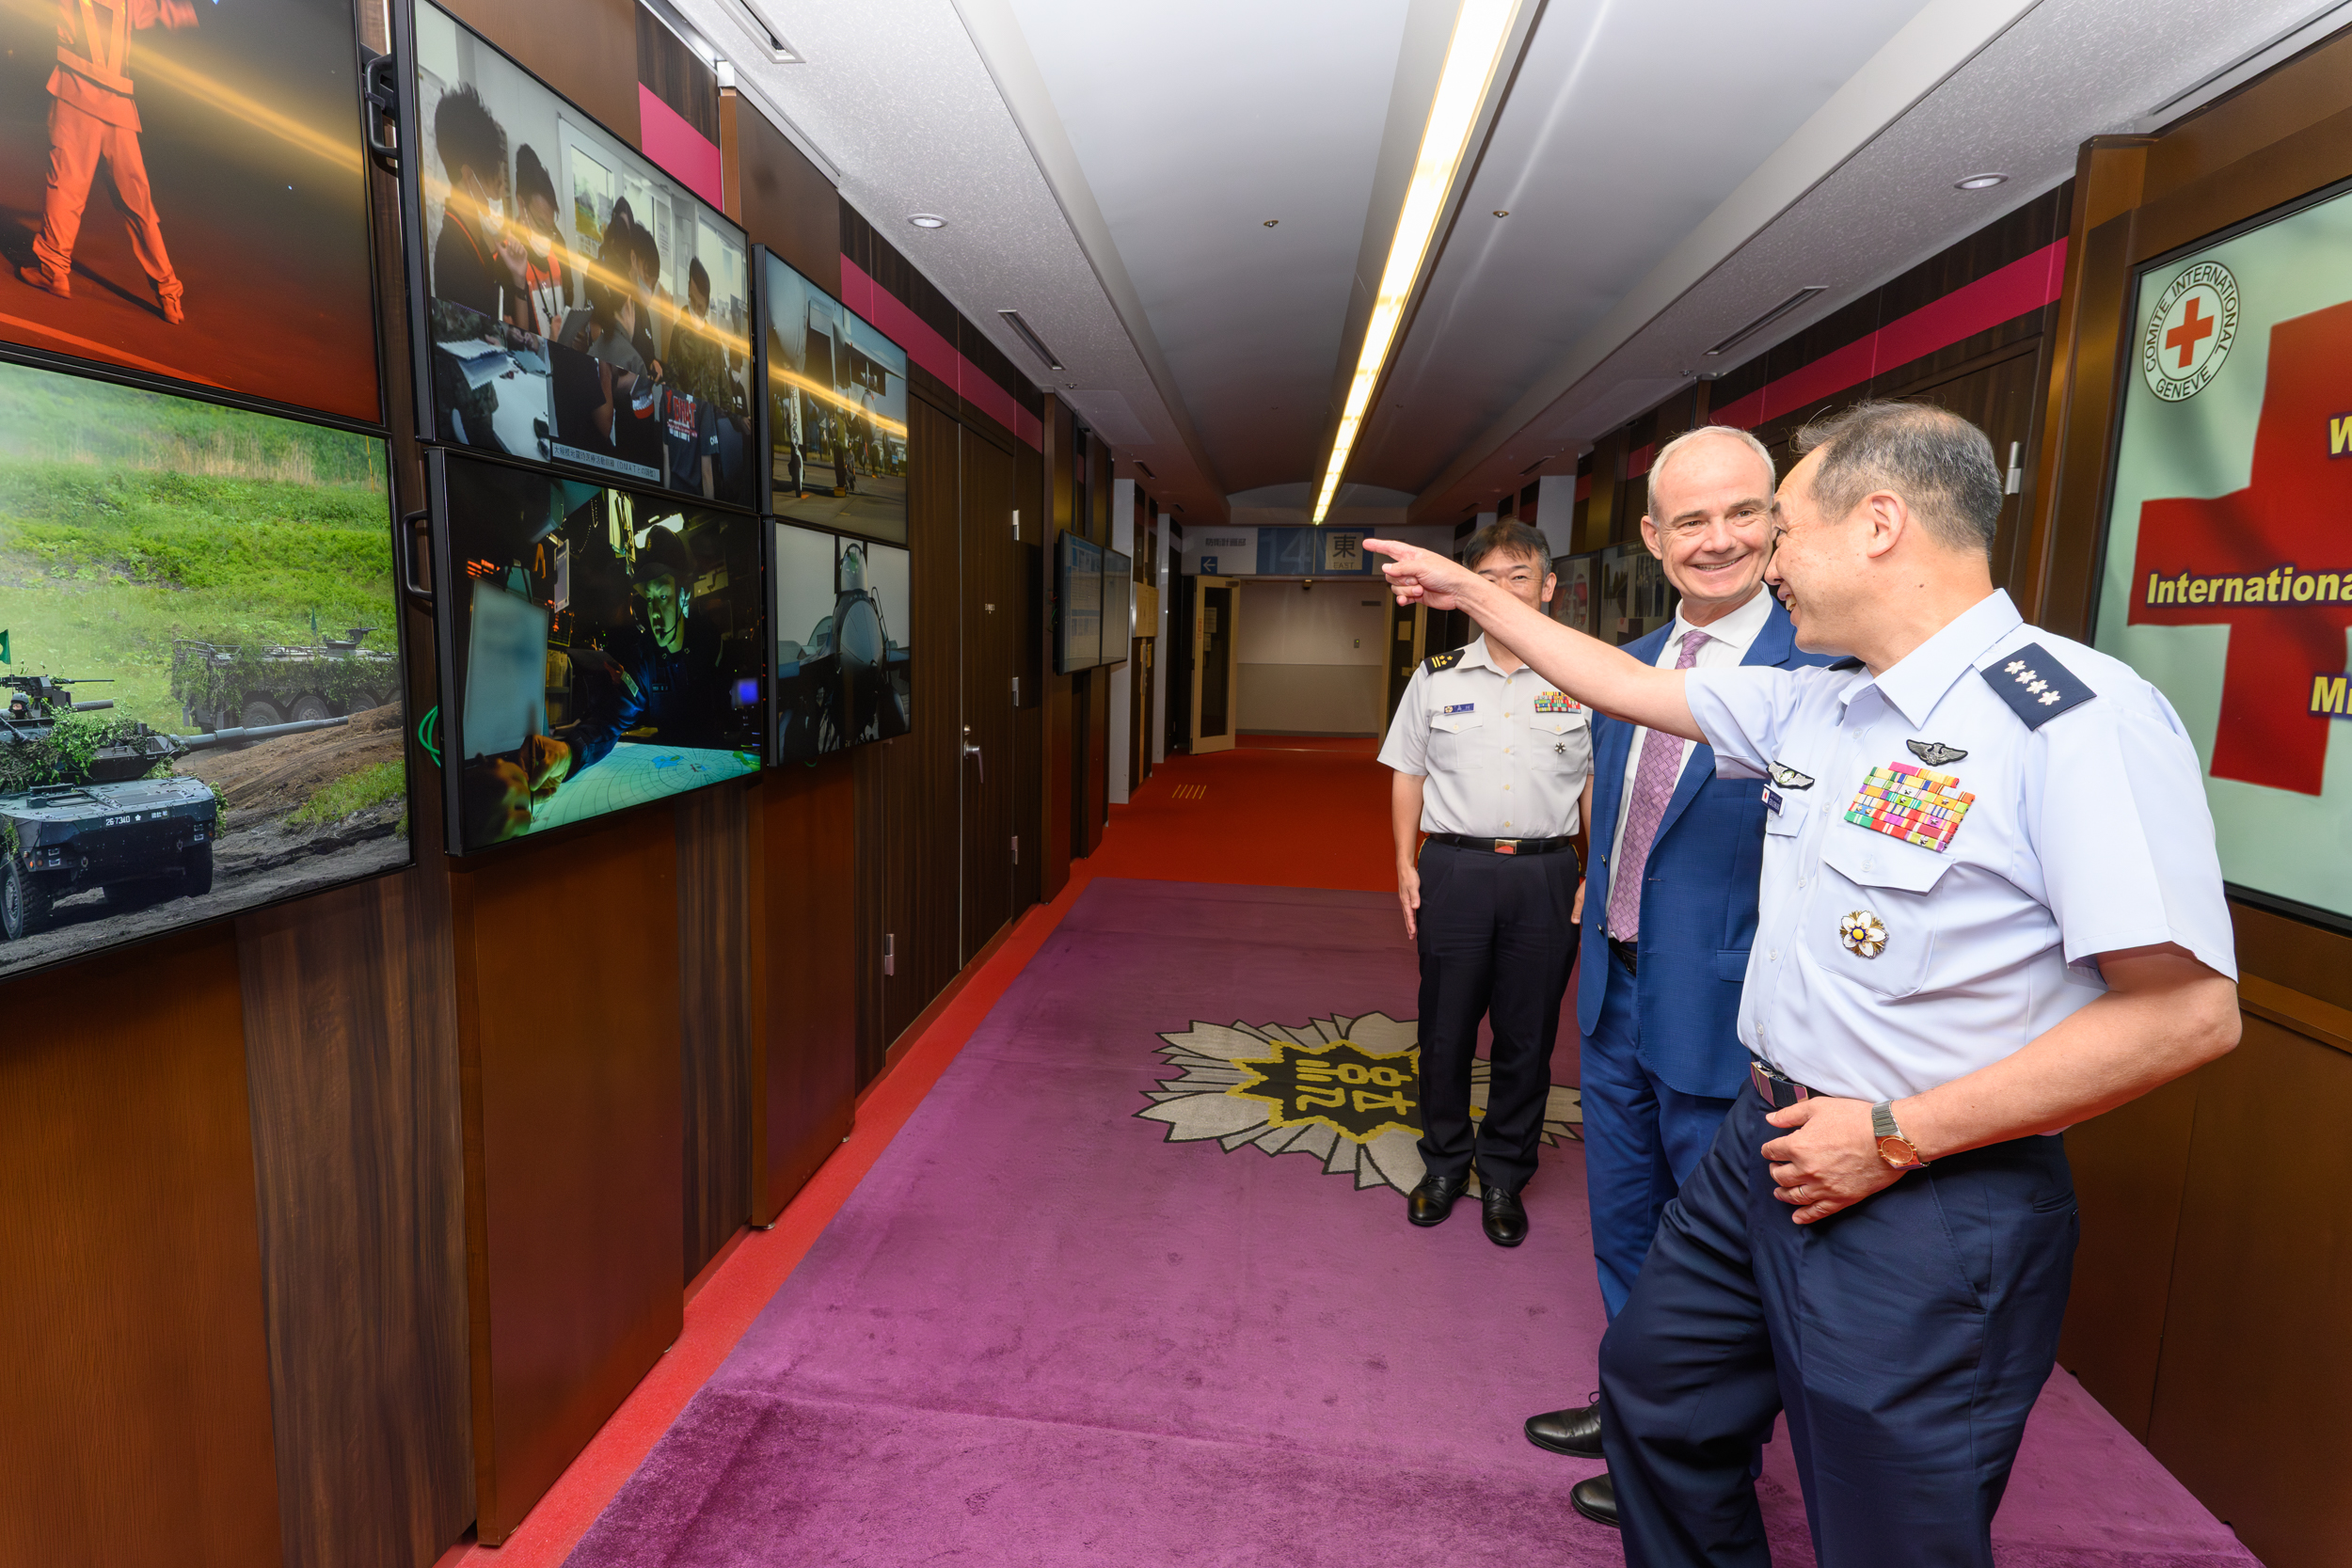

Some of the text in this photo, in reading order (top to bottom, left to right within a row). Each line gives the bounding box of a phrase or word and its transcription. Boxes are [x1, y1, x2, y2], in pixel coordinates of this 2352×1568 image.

[2145, 265, 2237, 372] COMITE INTERNATIONAL
[2155, 366, 2211, 399] GENEVE
[1332, 534, 1357, 558] 東
[1333, 562, 1355, 570] EAST
[2311, 675, 2352, 715] M
